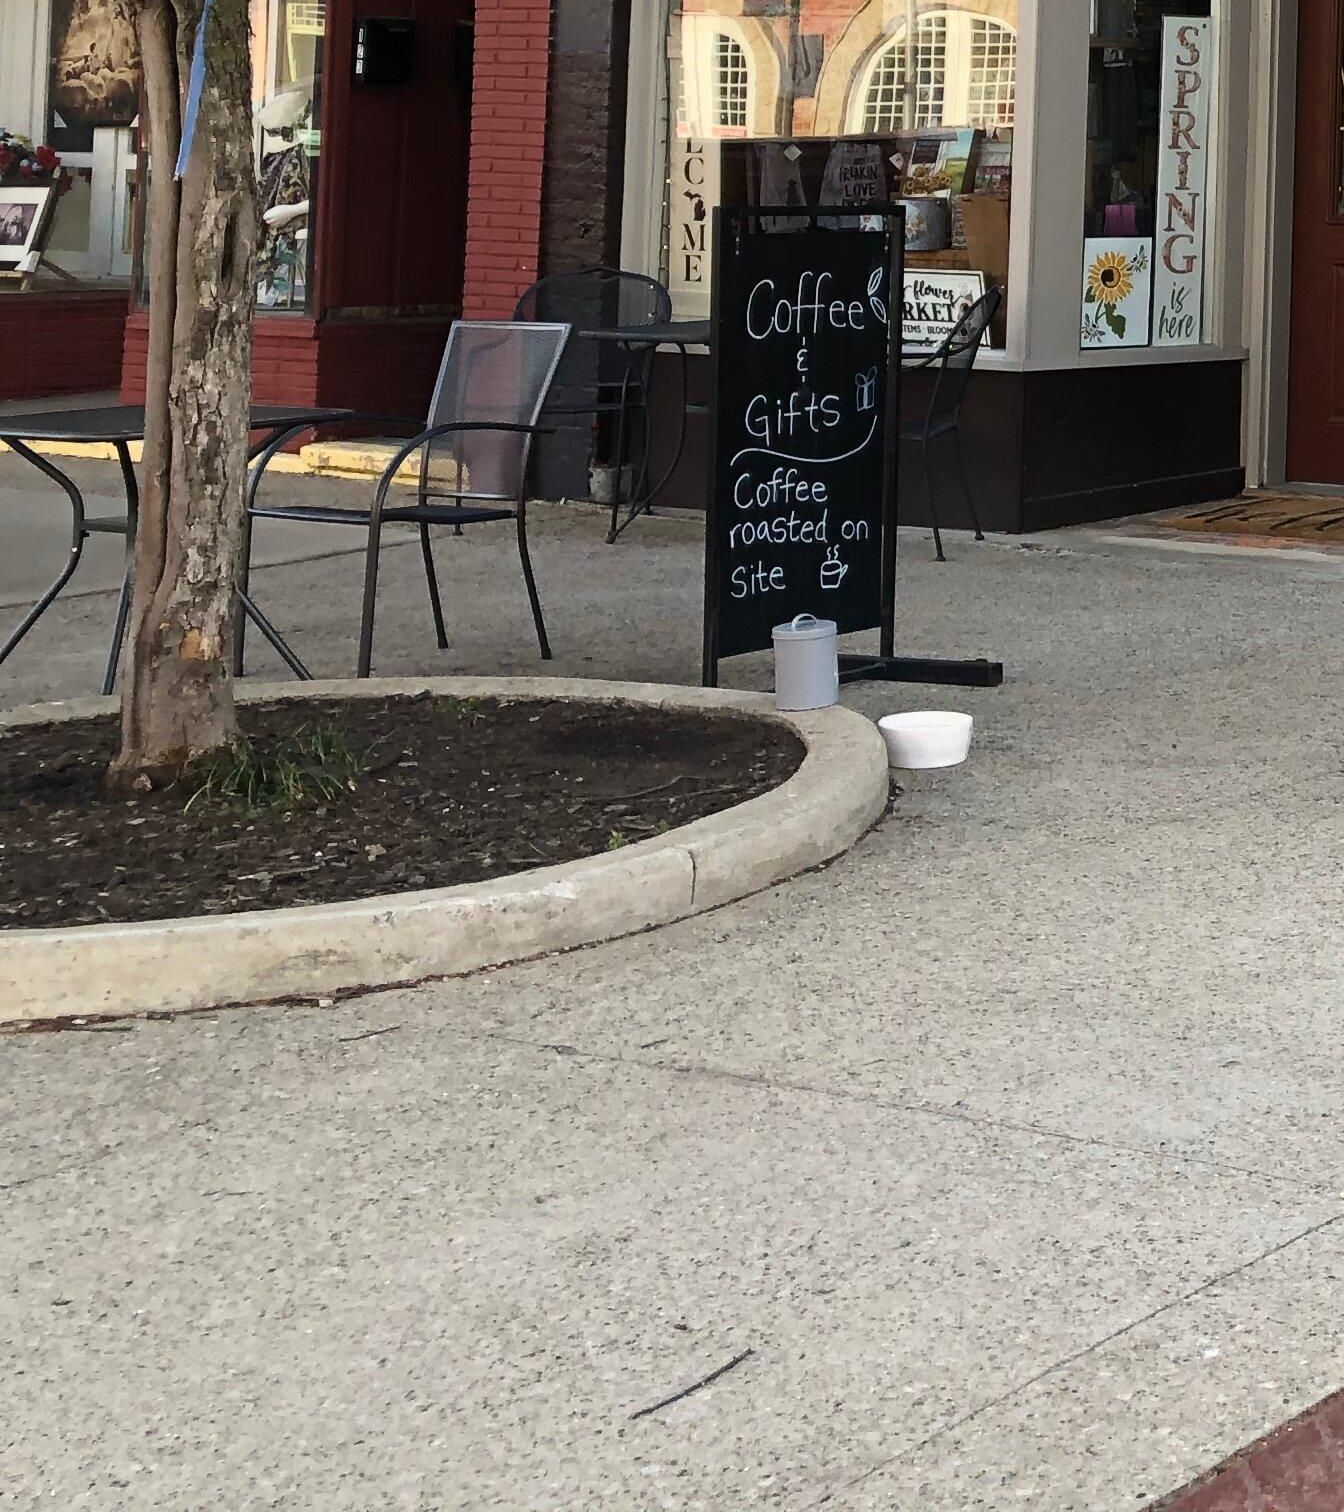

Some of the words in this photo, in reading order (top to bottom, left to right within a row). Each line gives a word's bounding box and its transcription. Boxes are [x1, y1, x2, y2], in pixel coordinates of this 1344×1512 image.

[1162, 25, 1201, 275] SPRING
[747, 271, 865, 340] Coffee
[913, 279, 954, 301] flower
[1170, 281, 1193, 312] is
[903, 301, 957, 323] RKET
[1158, 305, 1197, 339] here
[745, 392, 841, 446] Gifts
[734, 467, 828, 509] Coffee
[729, 508, 829, 549] roasted
[841, 520, 869, 541] on
